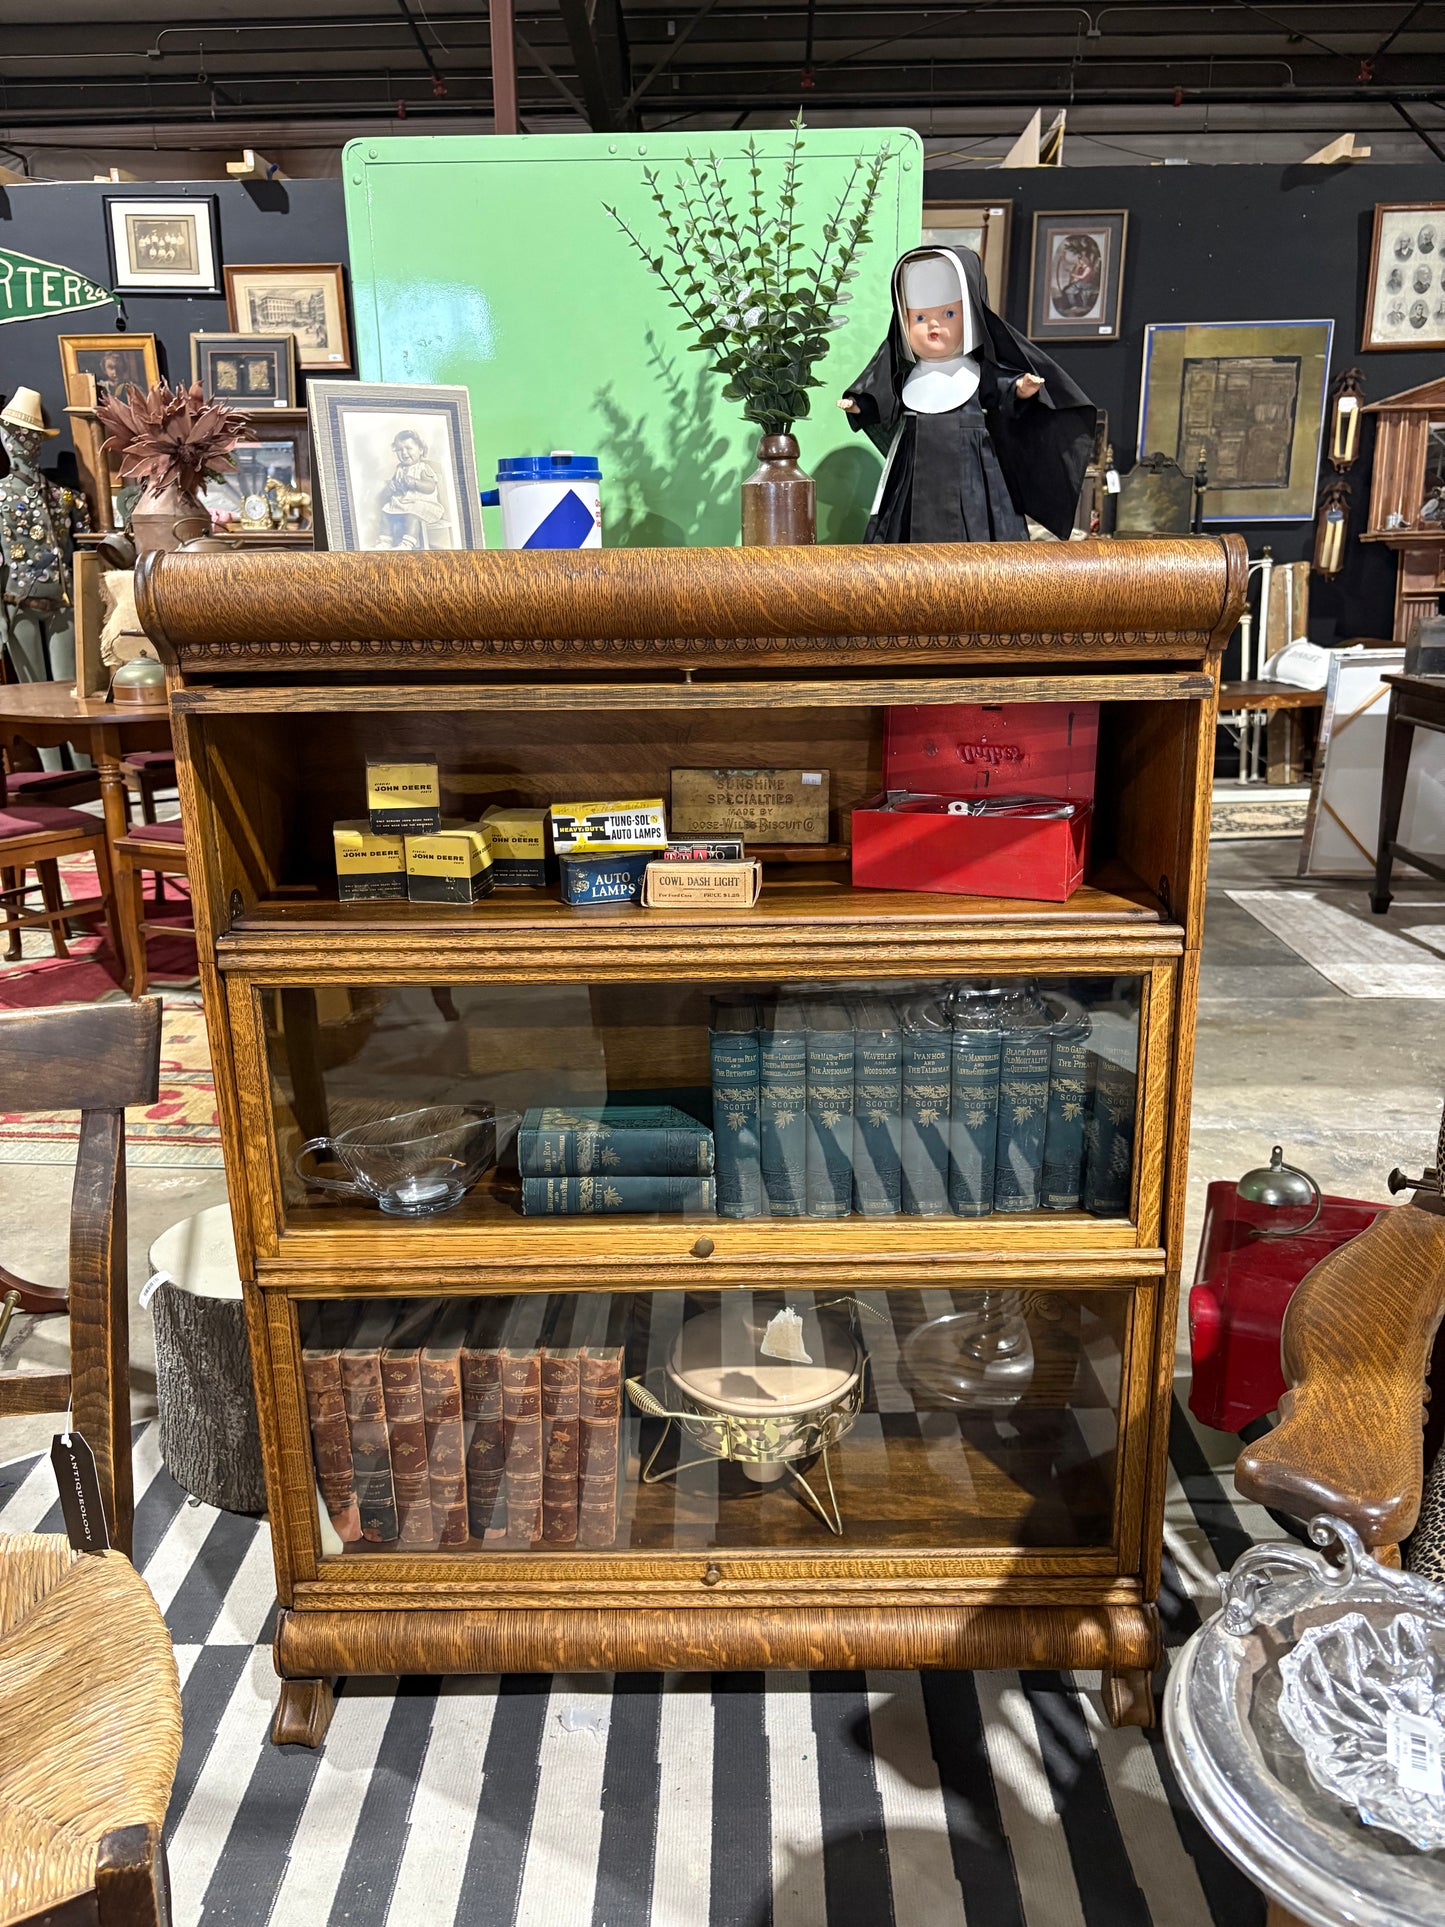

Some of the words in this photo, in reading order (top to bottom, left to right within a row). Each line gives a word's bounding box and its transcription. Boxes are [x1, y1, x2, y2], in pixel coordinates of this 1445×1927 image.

[717, 780, 785, 790] SUNSHINE
[708, 794, 794, 805] SPECIALTIES
[728, 808, 755, 816] MADE
[760, 808, 773, 816] BY
[610, 815, 650, 826] TUNG-SOL
[611, 829, 632, 840] AUTO
[634, 828, 661, 839] LAMPS
[596, 872, 630, 885] AUTO
[660, 877, 684, 886] COWL
[688, 877, 710, 886] DASH
[714, 877, 740, 886] LIGHT
[592, 884, 636, 897] LAMPS
[1006, 1048, 1026, 1056] BLACK
[1056, 1044, 1069, 1052] RED
[863, 1052, 896, 1060] WAVERLEY
[914, 1052, 945, 1060] IVANHOE
[1058, 1059, 1071, 1068] THE
[1074, 1060, 1096, 1069] PIRAT
[863, 1066, 897, 1075] WOODSTOCK
[908, 1066, 921, 1074] THE
[543, 1141, 551, 1156] ROY
[70, 1454, 92, 1542] ANTIQUEOLOGY
